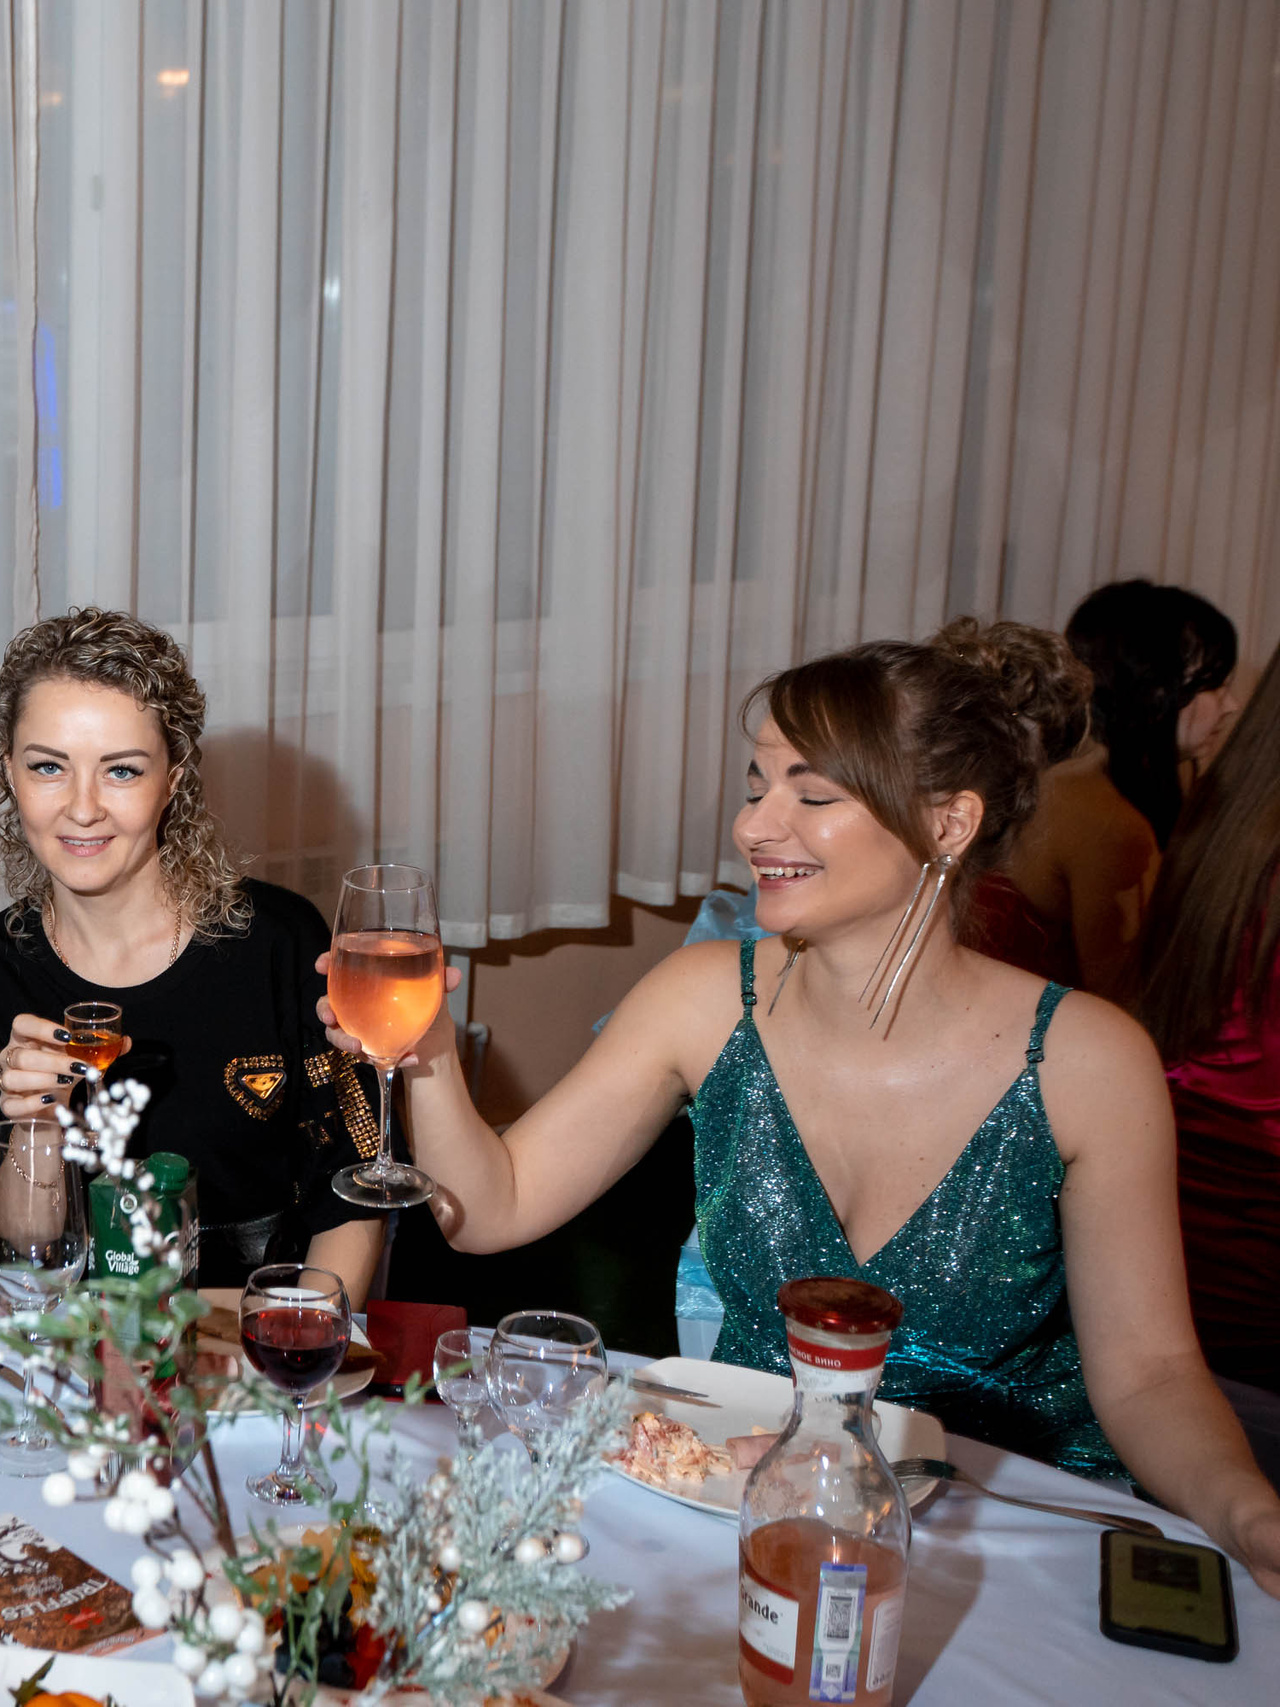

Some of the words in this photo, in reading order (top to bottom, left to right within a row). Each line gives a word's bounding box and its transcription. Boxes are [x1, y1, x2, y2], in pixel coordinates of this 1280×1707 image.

[105, 1249, 135, 1262] Global
[107, 1259, 140, 1275] Village
[815, 1356, 842, 1368] ВИНО
[1, 1578, 109, 1622] TRUFFLES
